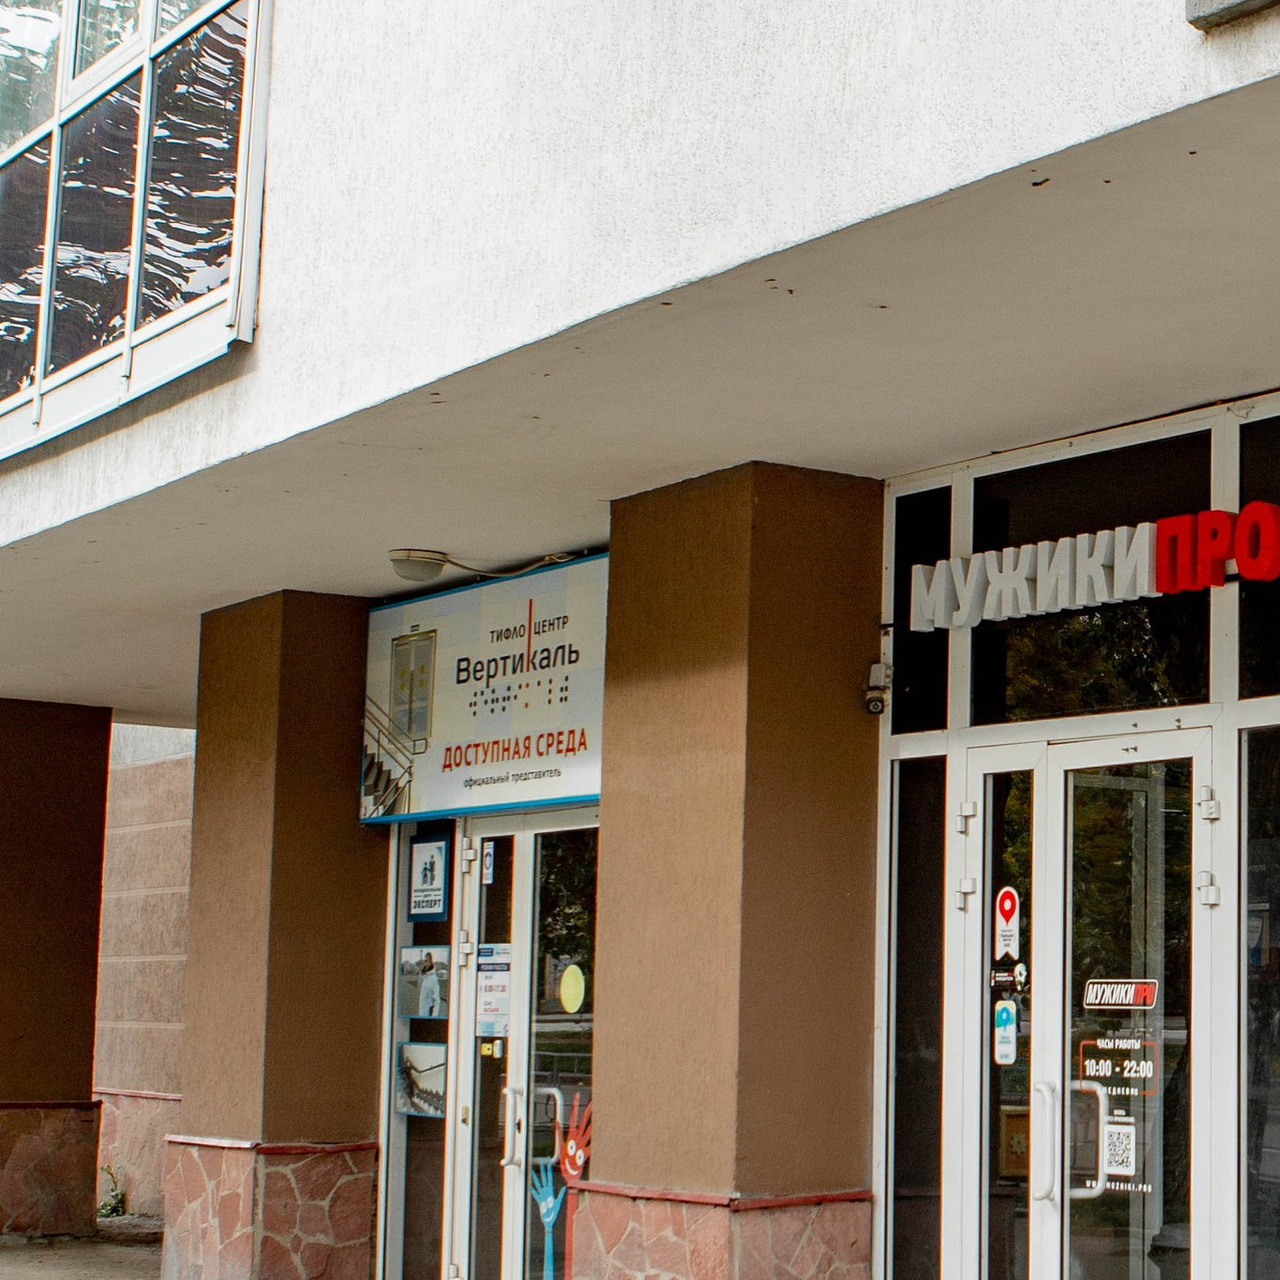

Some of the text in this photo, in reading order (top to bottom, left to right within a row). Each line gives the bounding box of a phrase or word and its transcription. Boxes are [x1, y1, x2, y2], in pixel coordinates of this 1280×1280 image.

[490, 615, 569, 643] ТИФЛО ЦЕНТР
[456, 643, 580, 689] Вертикаль
[442, 728, 588, 772] ДОСТУПНАЯ СРЕДА
[464, 768, 562, 789] официальный представитель
[1097, 1039, 1141, 1049] ЧАСЫ РАБОТЫ
[1084, 1059, 1112, 1077] 10:00
[1123, 1060, 1154, 1078] 22:00
